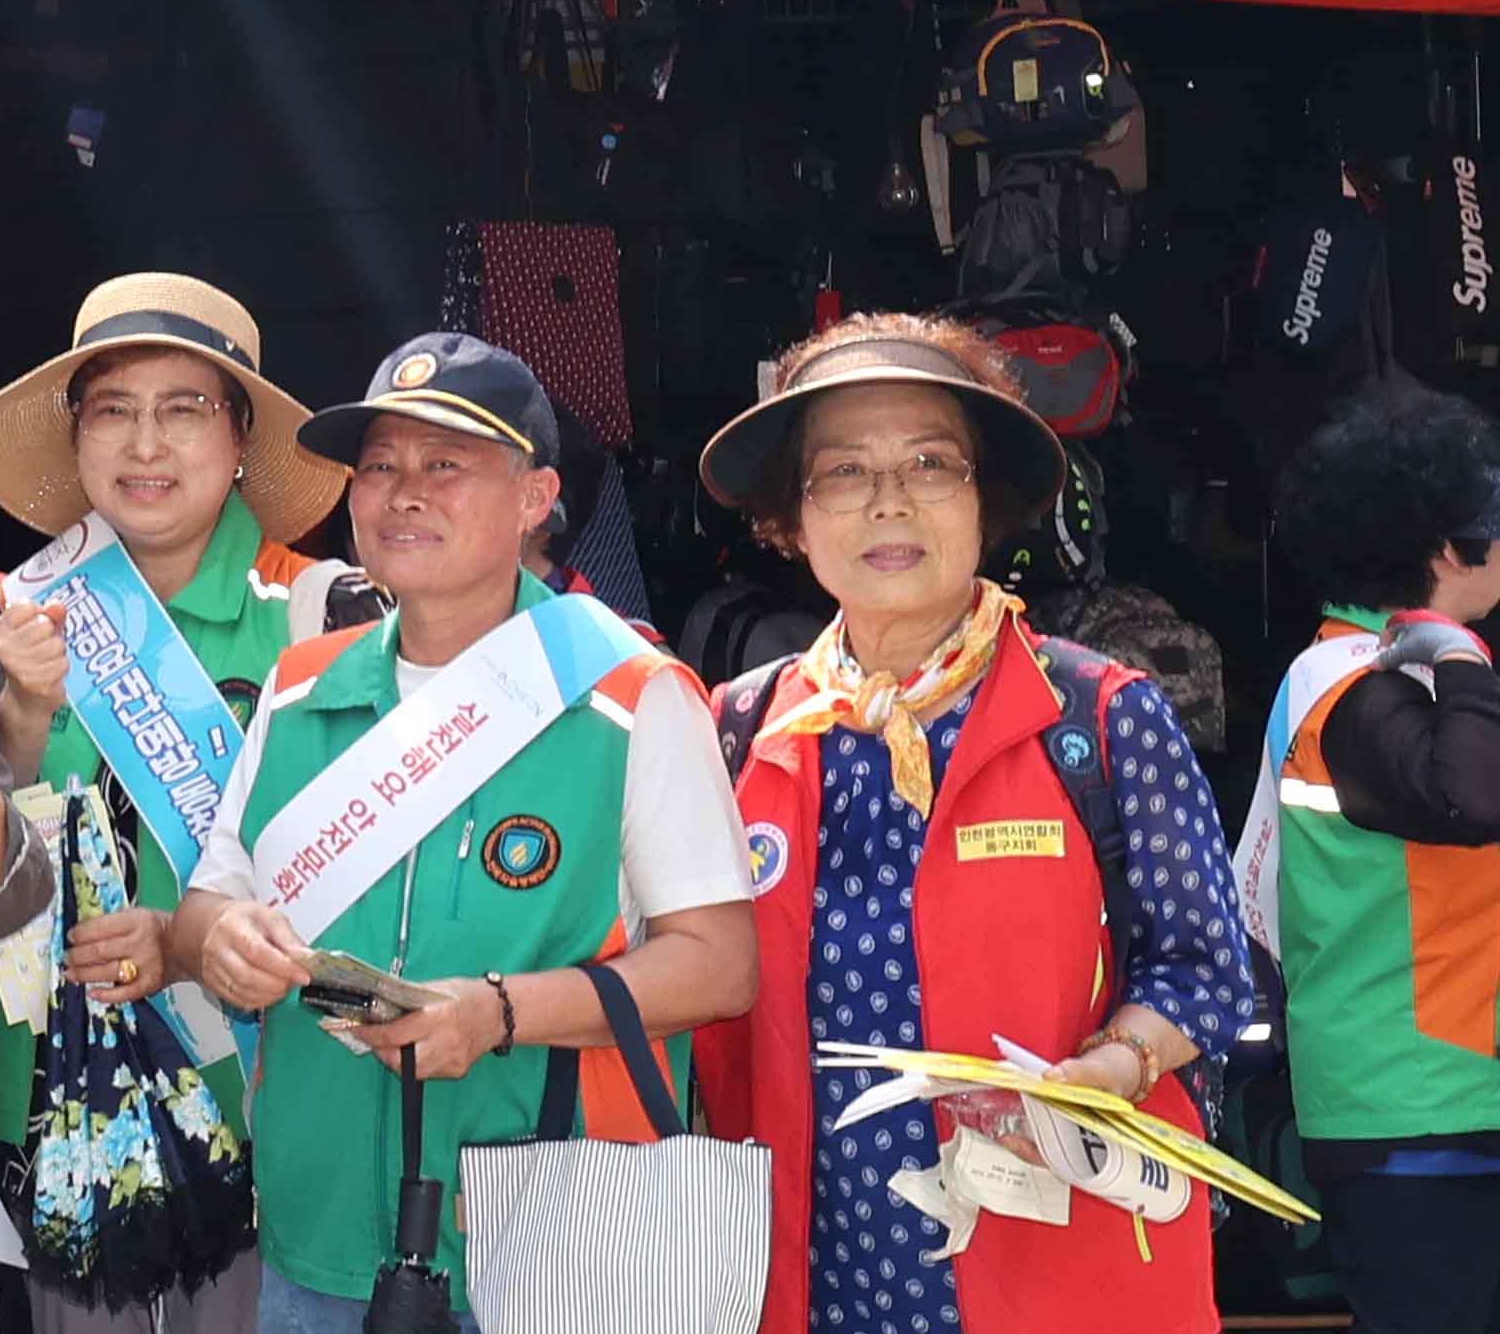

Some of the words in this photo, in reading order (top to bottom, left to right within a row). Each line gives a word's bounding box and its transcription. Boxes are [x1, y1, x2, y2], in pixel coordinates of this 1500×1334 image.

[1283, 227, 1333, 345] Supreme
[1451, 155, 1485, 314] Supreme
[370, 699, 490, 810] 실천해요
